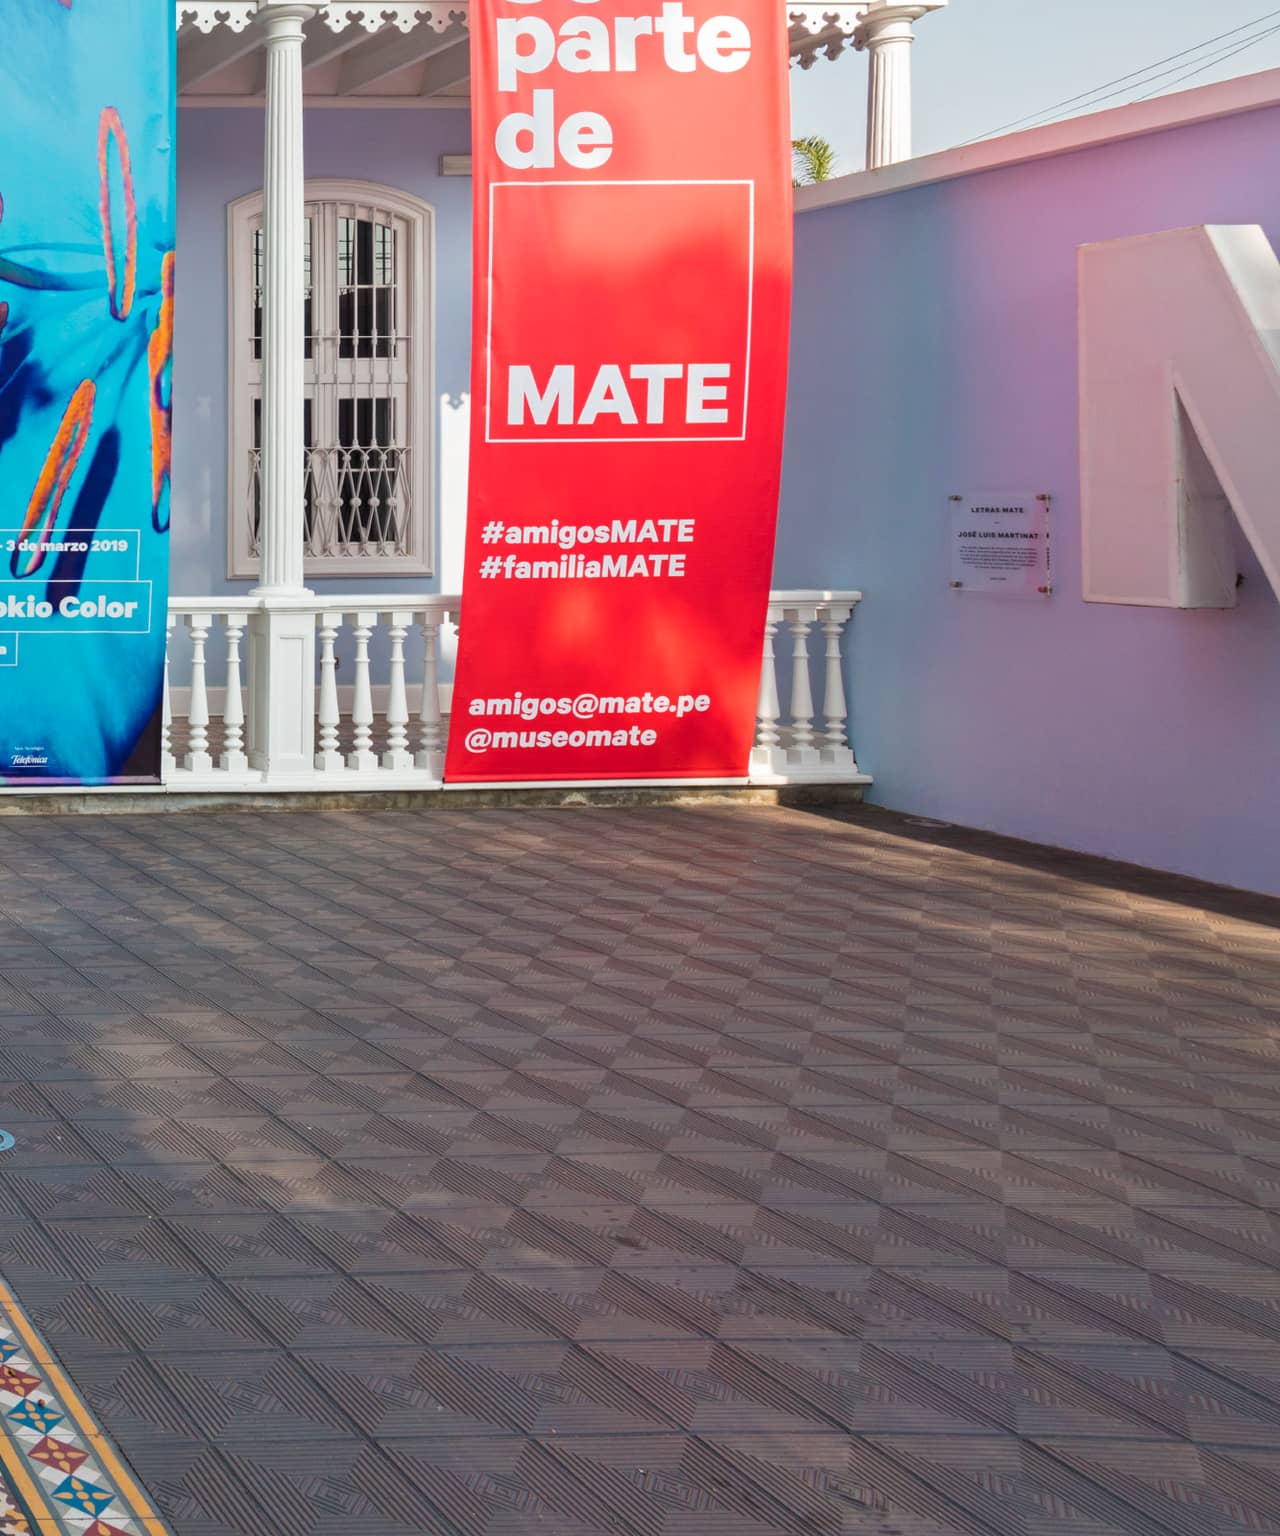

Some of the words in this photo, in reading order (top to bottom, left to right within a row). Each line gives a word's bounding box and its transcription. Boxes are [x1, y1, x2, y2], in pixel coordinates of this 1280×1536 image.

[495, 1, 752, 91] parte
[495, 90, 613, 171] de
[506, 364, 731, 426] MATE
[6, 540, 16, 552] 3
[19, 540, 39, 552] de
[41, 542, 88, 552] marzo
[91, 540, 128, 552] 2019
[481, 519, 695, 549] #amigosMATE
[479, 554, 686, 579] #familiaMATE
[59, 596, 138, 618] Color
[468, 691, 710, 720] amigos@mate.pe
[465, 726, 656, 753] @museomate
